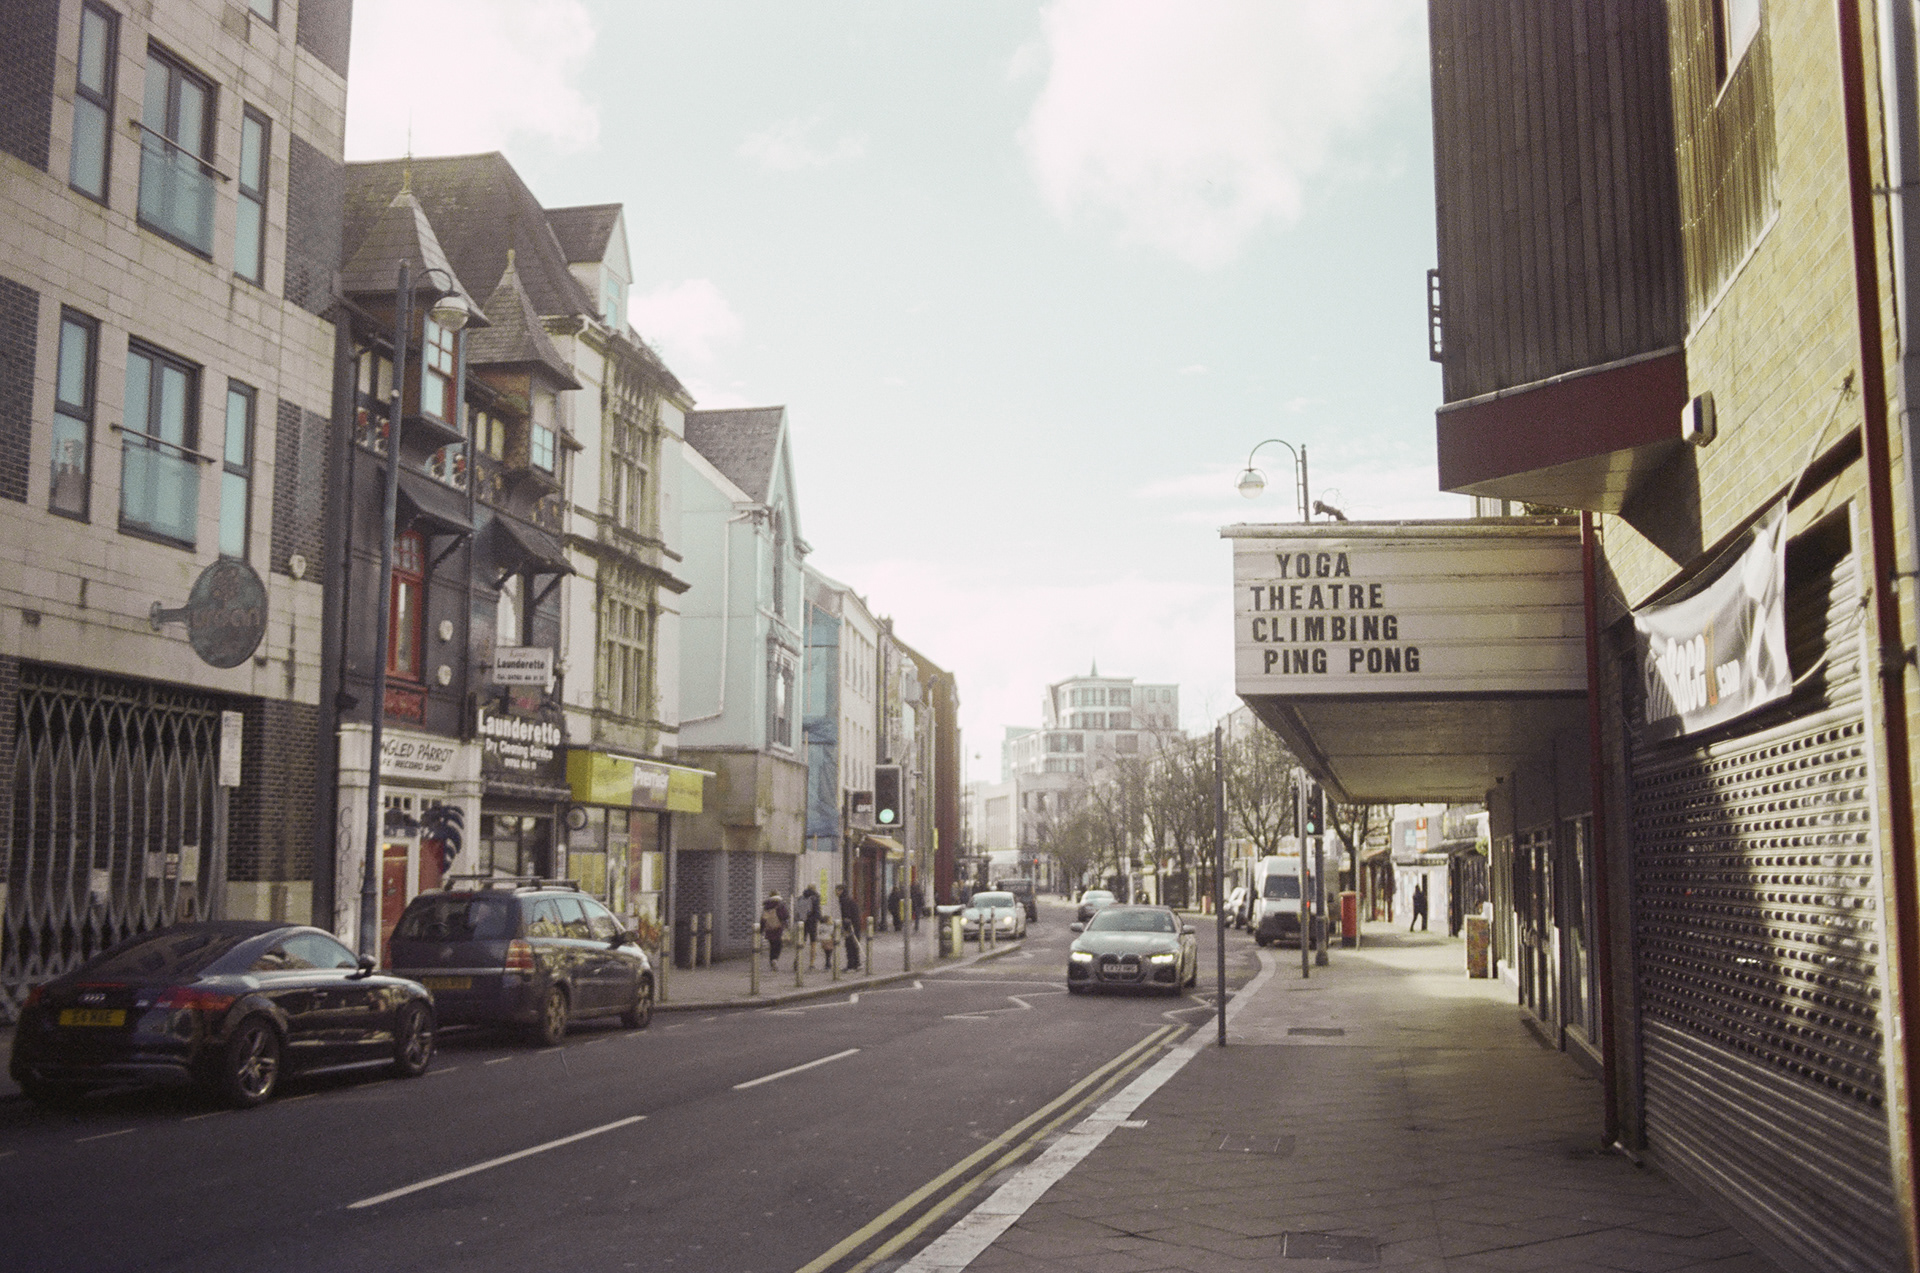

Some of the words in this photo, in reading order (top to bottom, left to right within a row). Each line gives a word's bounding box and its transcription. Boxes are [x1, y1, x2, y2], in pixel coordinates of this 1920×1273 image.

[1276, 552, 1350, 579] YOGA
[1250, 583, 1383, 611] THEATRE
[1252, 614, 1398, 642] CLIMBING
[497, 659, 546, 670] Launderette
[1264, 648, 1327, 674] PING
[1349, 646, 1420, 673] PONG
[478, 707, 561, 746] Launderette
[417, 741, 455, 763] PARROT
